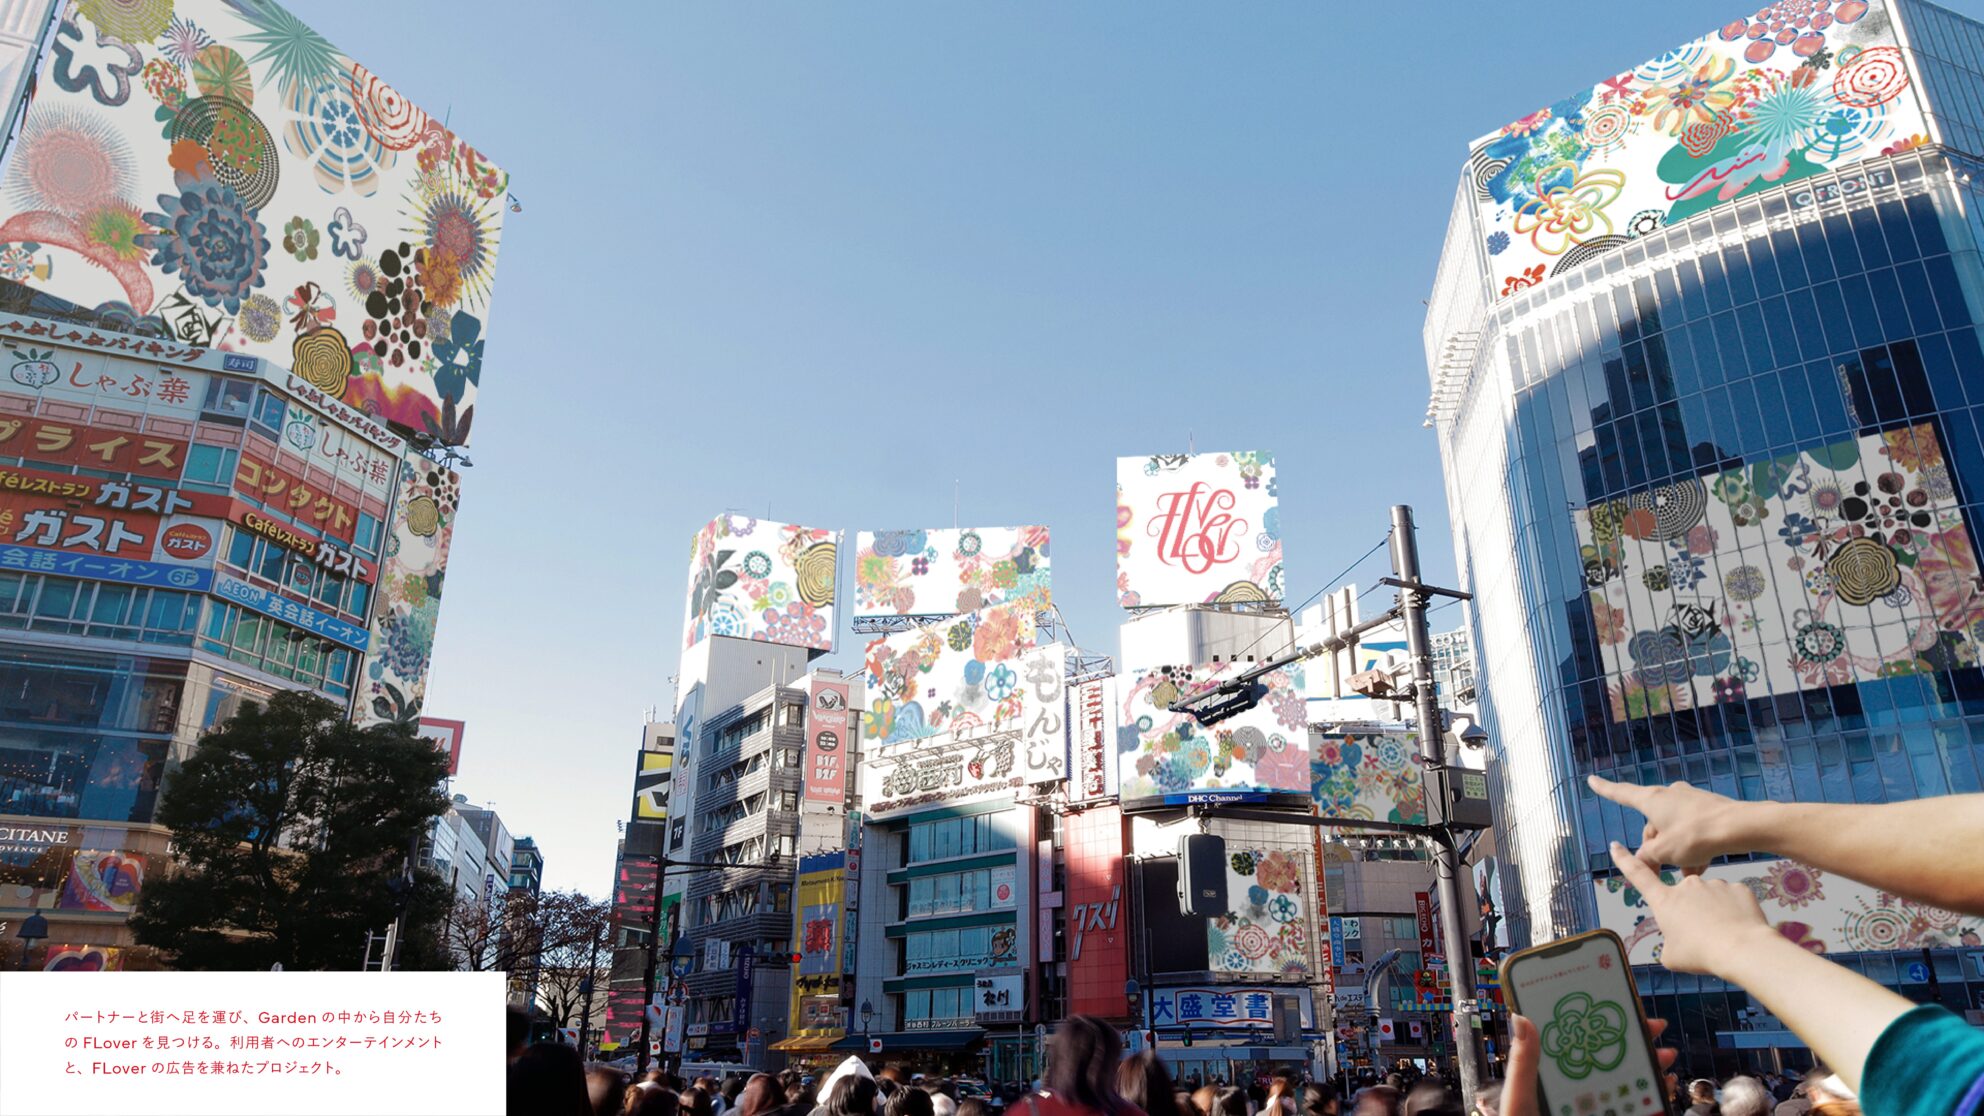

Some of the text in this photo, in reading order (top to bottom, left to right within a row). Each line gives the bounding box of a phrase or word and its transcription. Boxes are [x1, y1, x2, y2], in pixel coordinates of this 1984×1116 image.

[69, 362, 191, 404] しゃぶ葉
[321, 431, 389, 485] しゃぶ葉
[95, 481, 193, 515] ガスト
[236, 456, 353, 529] コンタクト
[15, 510, 144, 552] ガスト
[167, 538, 206, 550] ガスト
[170, 571, 195, 584] 6F
[315, 542, 368, 580] ガスト
[221, 578, 262, 605] AEON
[267, 595, 367, 645] 英会話イーオン
[1025, 653, 1063, 776] もんじゃ
[816, 754, 837, 767] B1F
[1209, 794, 1243, 802] Channel
[673, 825, 683, 840] 7F
[1071, 884, 1121, 961] クスリ
